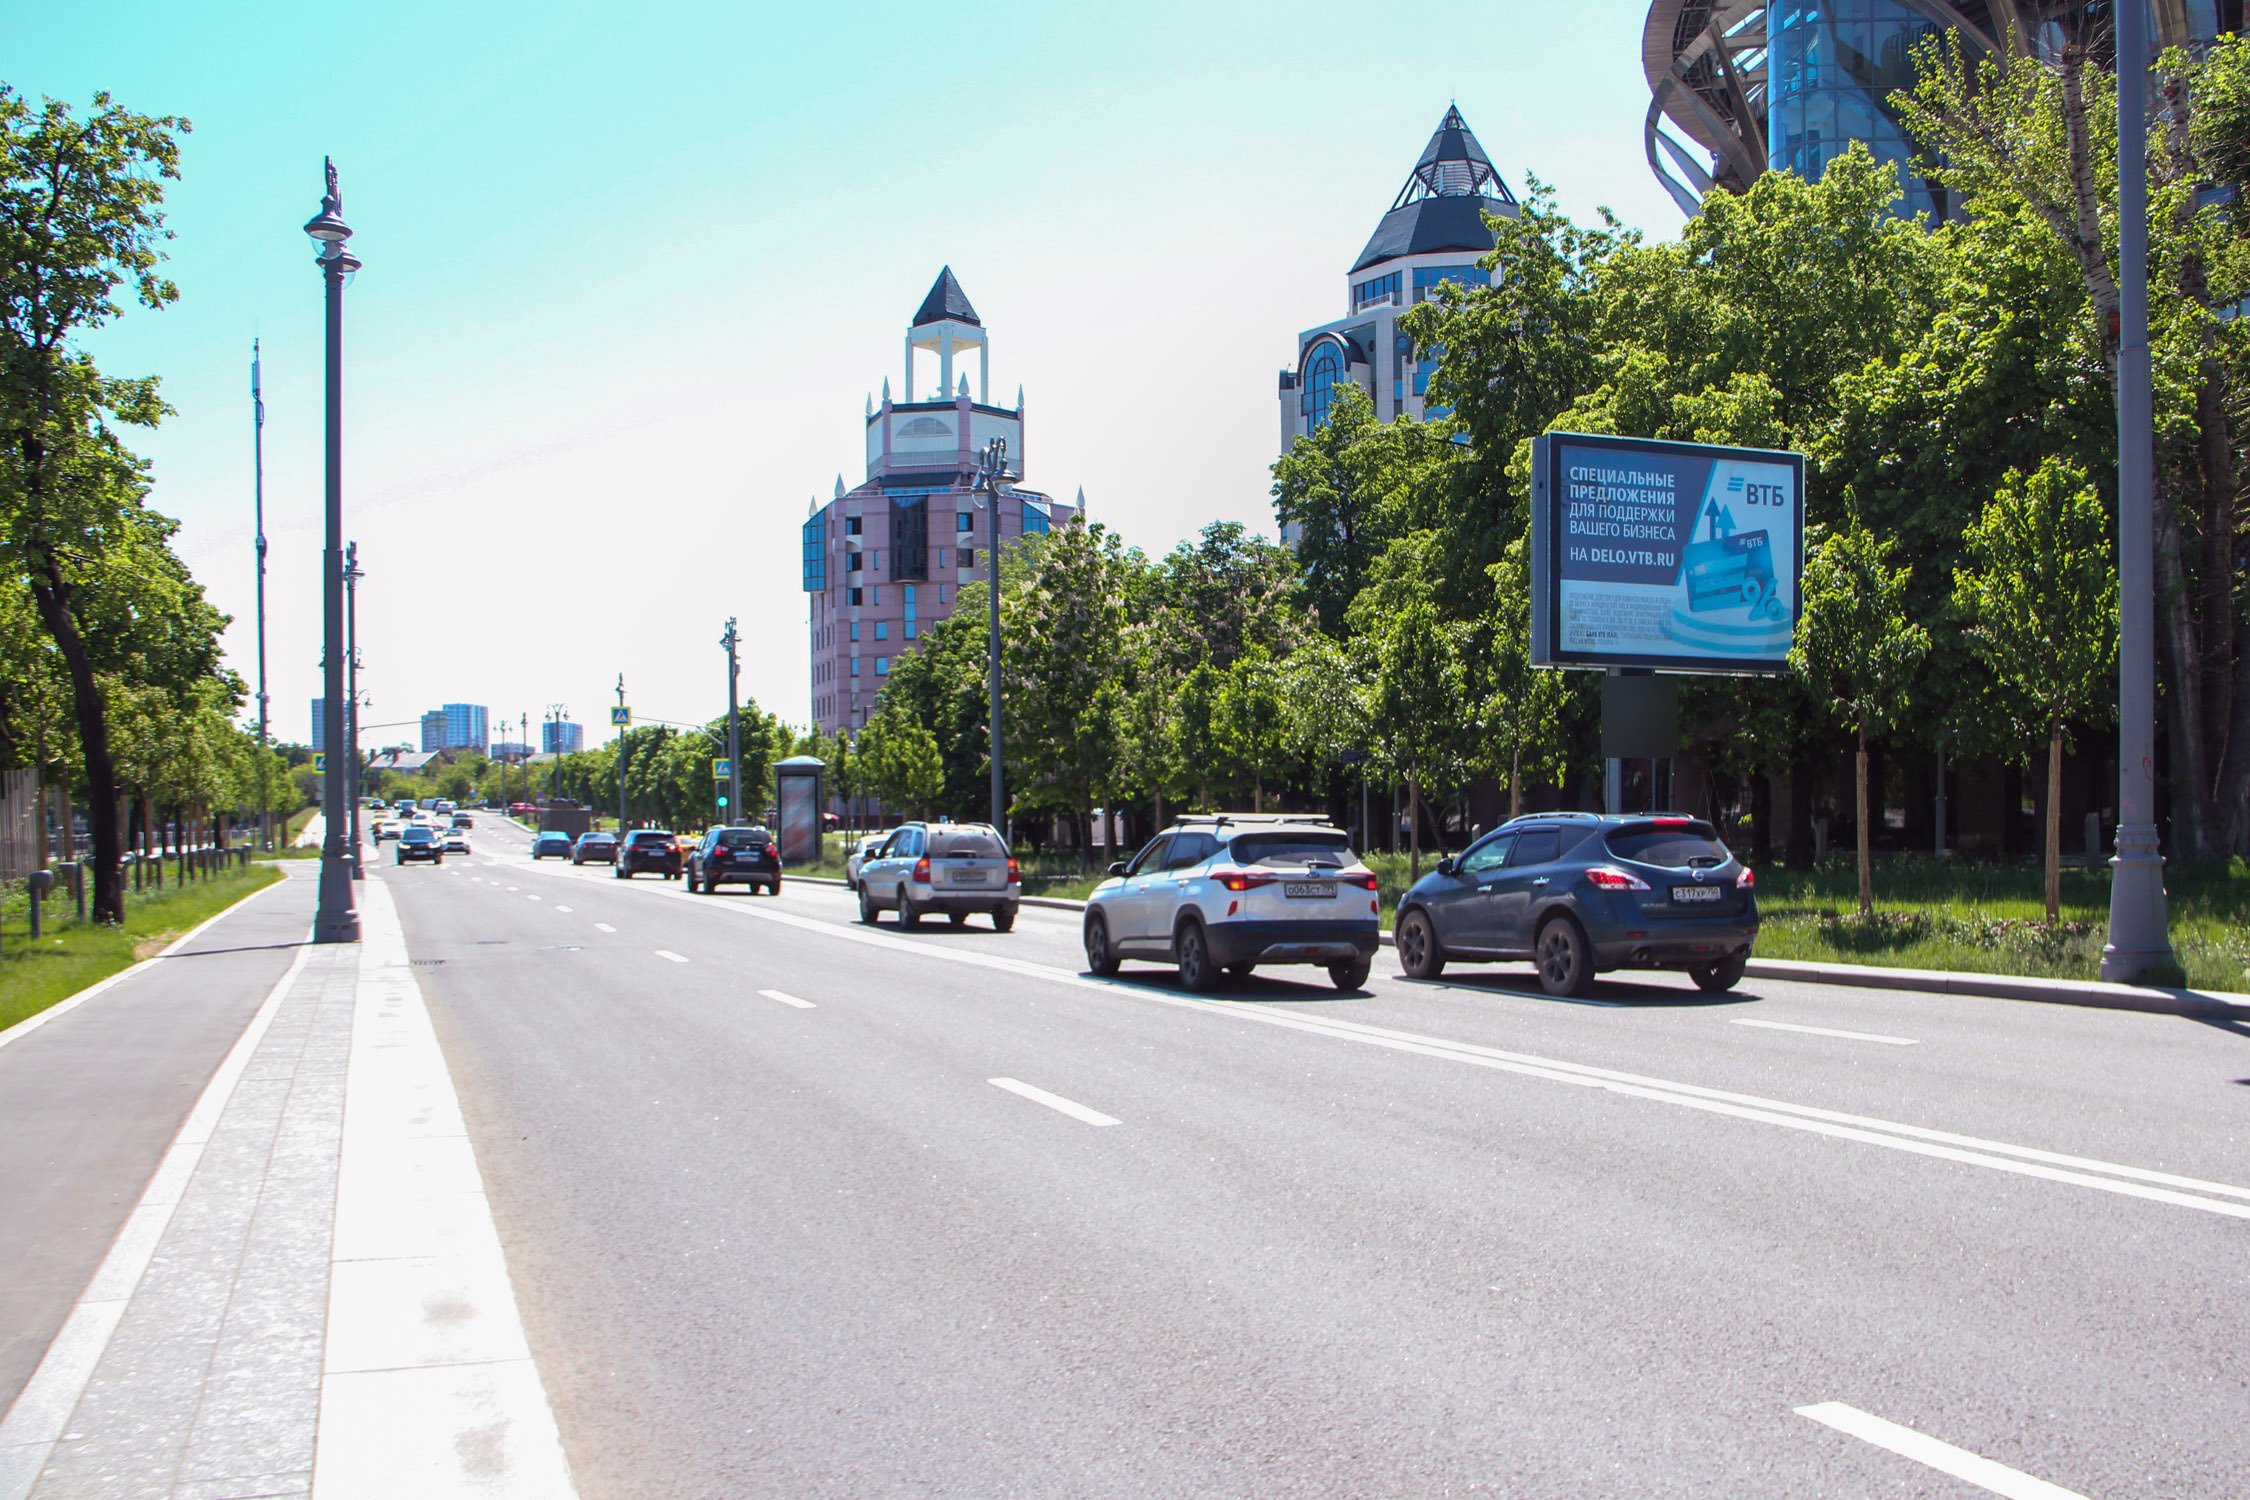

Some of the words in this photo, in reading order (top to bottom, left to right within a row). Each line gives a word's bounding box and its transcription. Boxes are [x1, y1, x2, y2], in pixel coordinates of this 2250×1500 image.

[1570, 467, 1675, 487] СПЕЦИАЛЬНЫЕ
[1570, 484, 1675, 505] ПРЕДЛОЖЕНИЯ
[1746, 483, 1784, 507] ВТБ
[1569, 502, 1595, 518] ДЛЯ
[1599, 505, 1675, 523] ПОДДЕРЖКИ
[1570, 521, 1620, 537] ВАШЕГО
[1623, 524, 1676, 541] БИЗНЕСА
[1746, 537, 1763, 549] ВТБ
[1570, 547, 1588, 561] НА
[1591, 548, 1675, 567] DELO.VTB.RU
